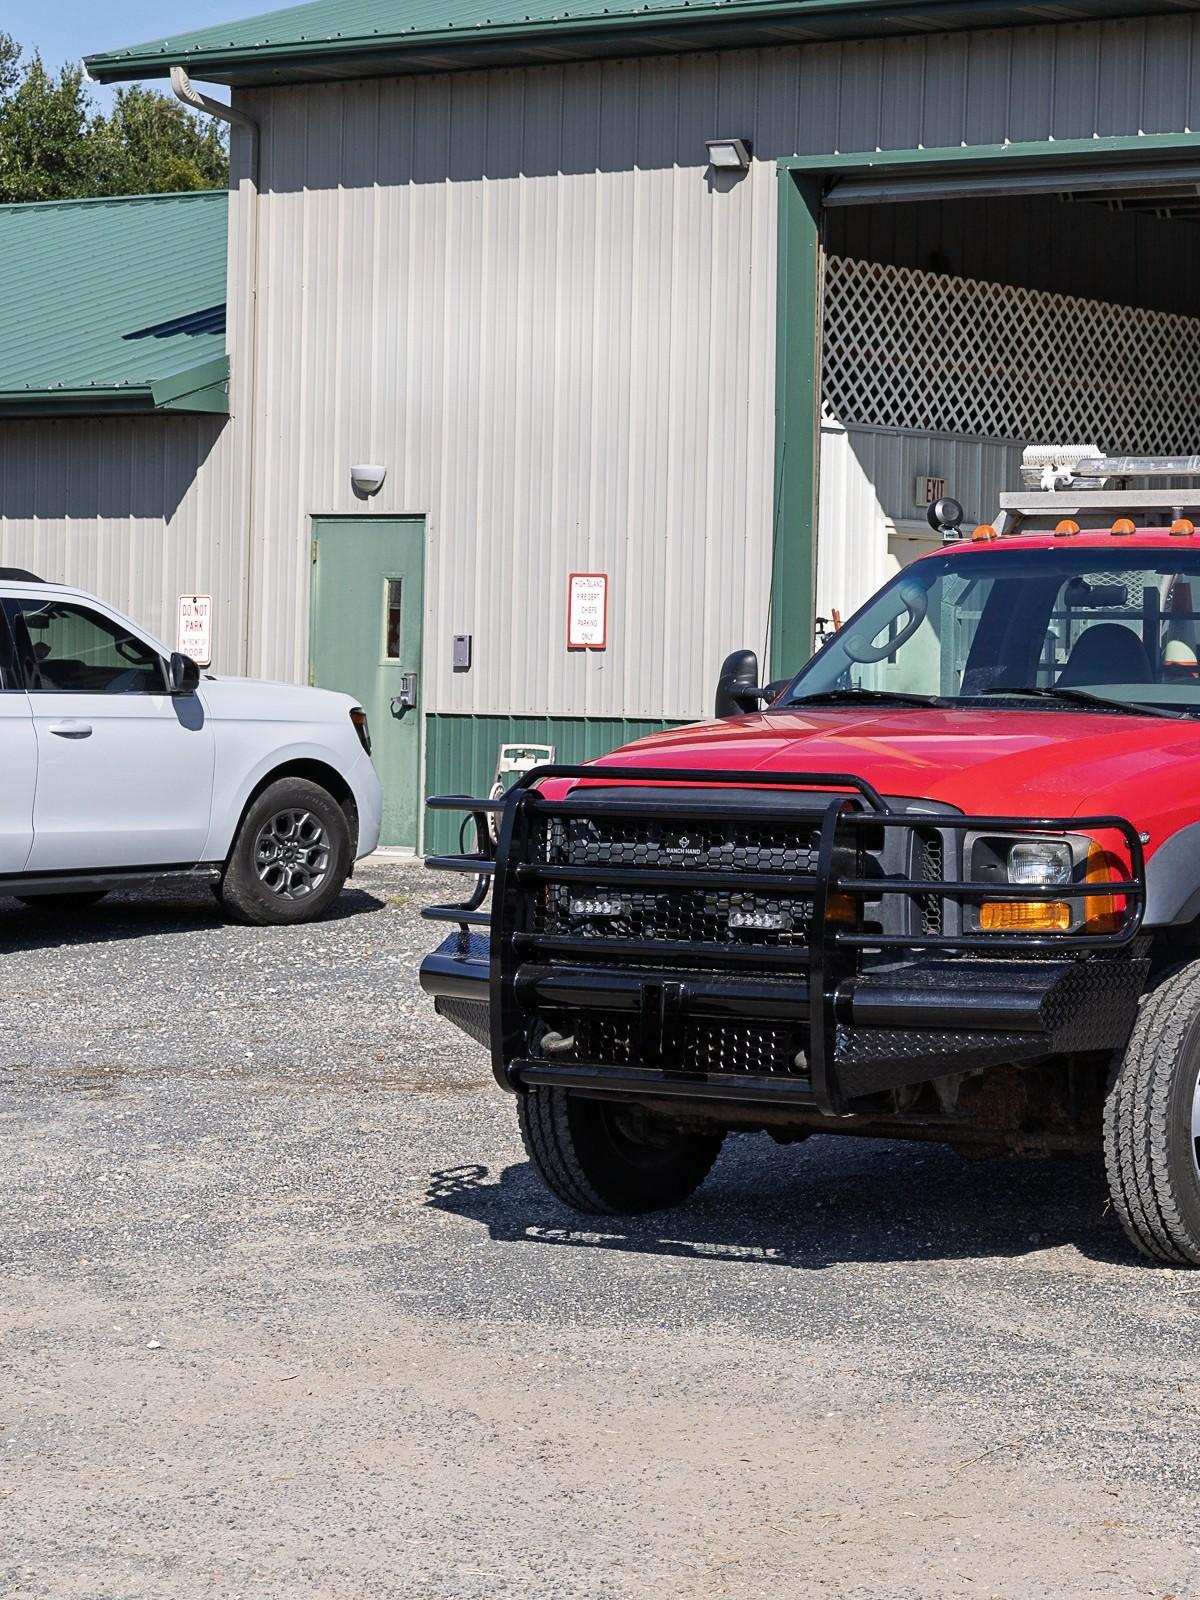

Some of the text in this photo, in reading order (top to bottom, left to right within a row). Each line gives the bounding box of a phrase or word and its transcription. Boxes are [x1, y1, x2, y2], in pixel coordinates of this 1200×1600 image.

[927, 479, 944, 502] EXIT
[183, 605, 207, 616] DO NOT
[185, 620, 203, 632] PARK
[577, 619, 598, 627] PARKING
[581, 632, 593, 640] ONLY
[184, 648, 202, 656] DOOR
